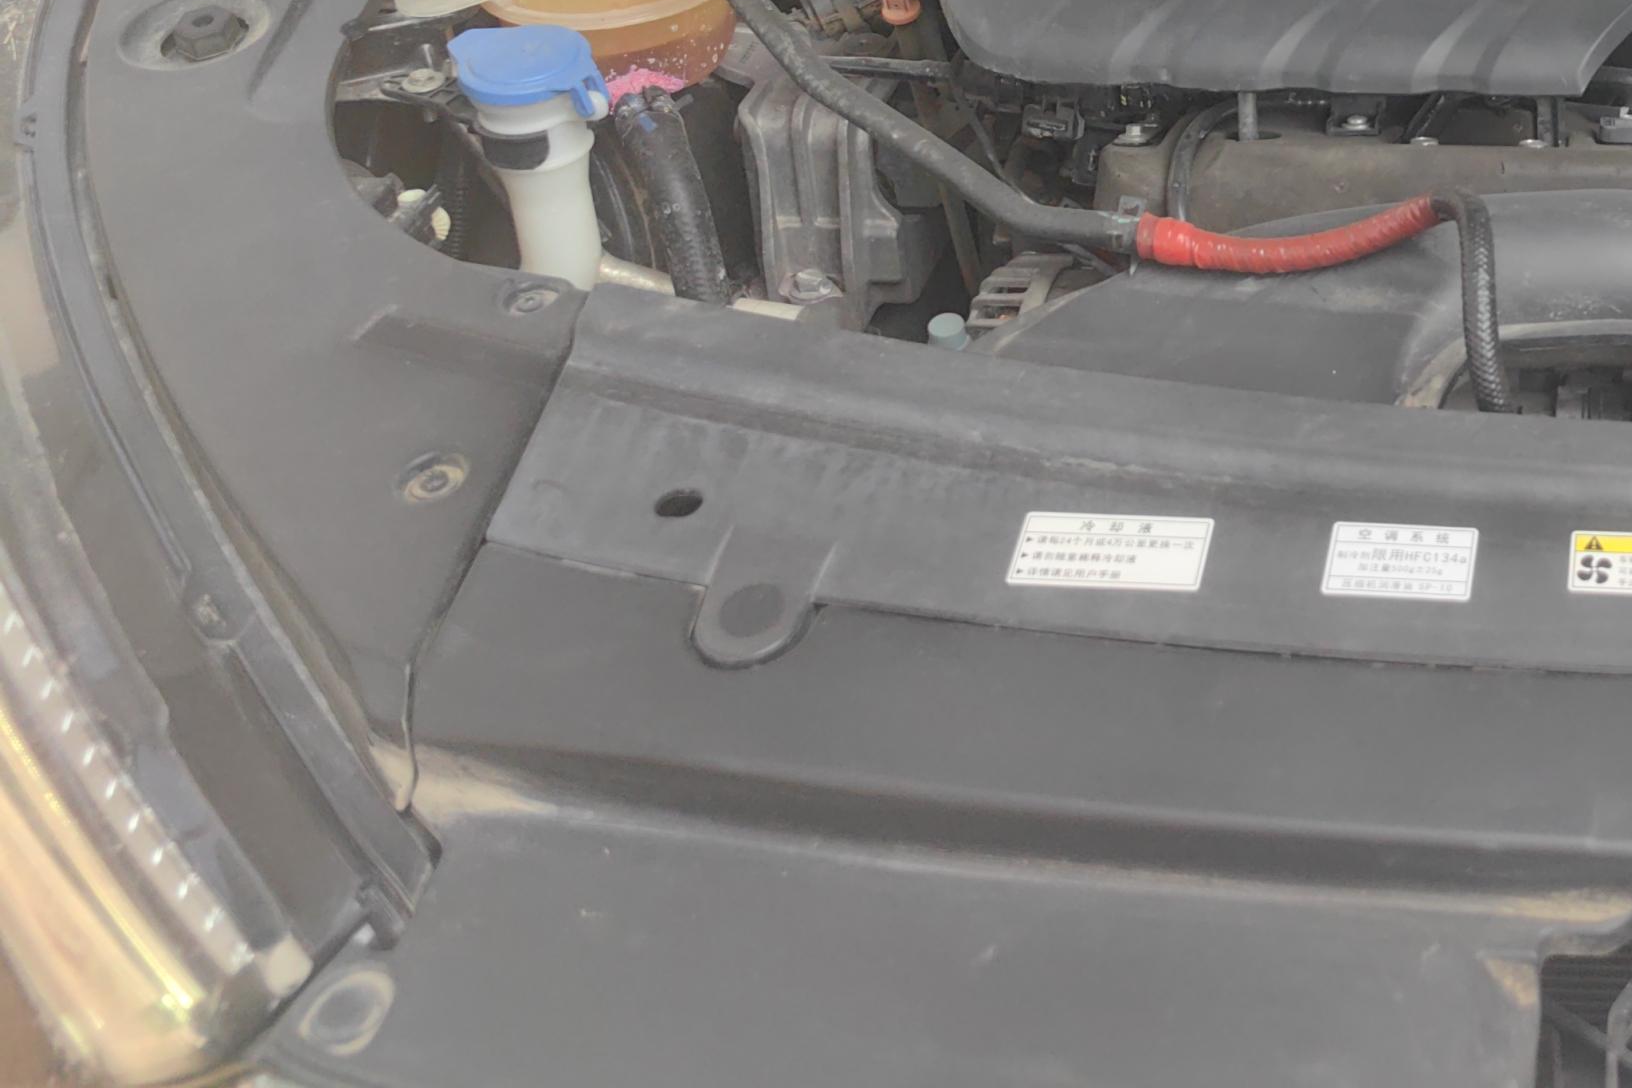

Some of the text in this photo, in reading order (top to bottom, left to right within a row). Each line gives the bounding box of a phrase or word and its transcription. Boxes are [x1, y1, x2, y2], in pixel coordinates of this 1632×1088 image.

[1080, 519, 1153, 534] 冷却液
[1357, 528, 1450, 544] 空调系统
